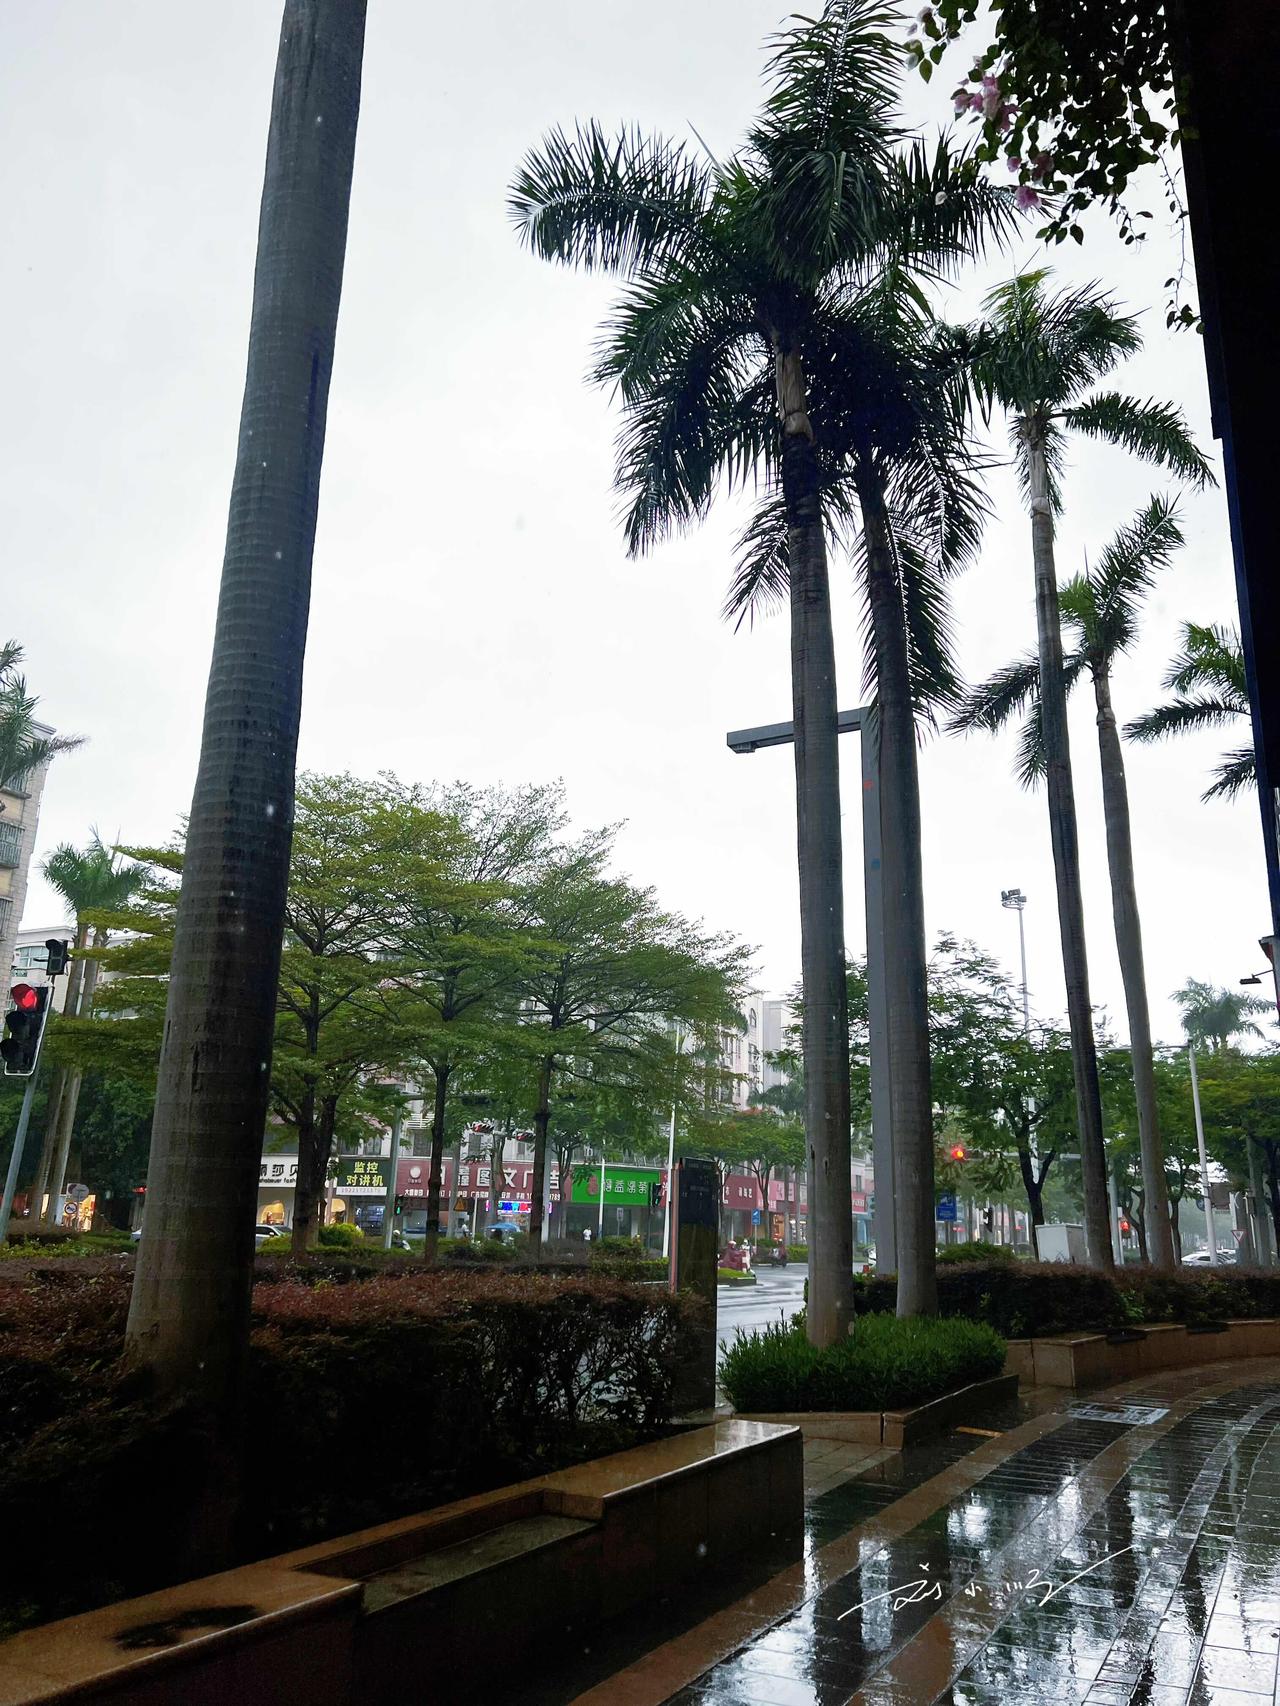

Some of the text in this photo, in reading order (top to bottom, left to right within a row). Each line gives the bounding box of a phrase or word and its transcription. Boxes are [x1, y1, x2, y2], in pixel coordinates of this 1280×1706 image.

[353, 1161, 379, 1174] 监控
[346, 1174, 384, 1187] 对讲机
